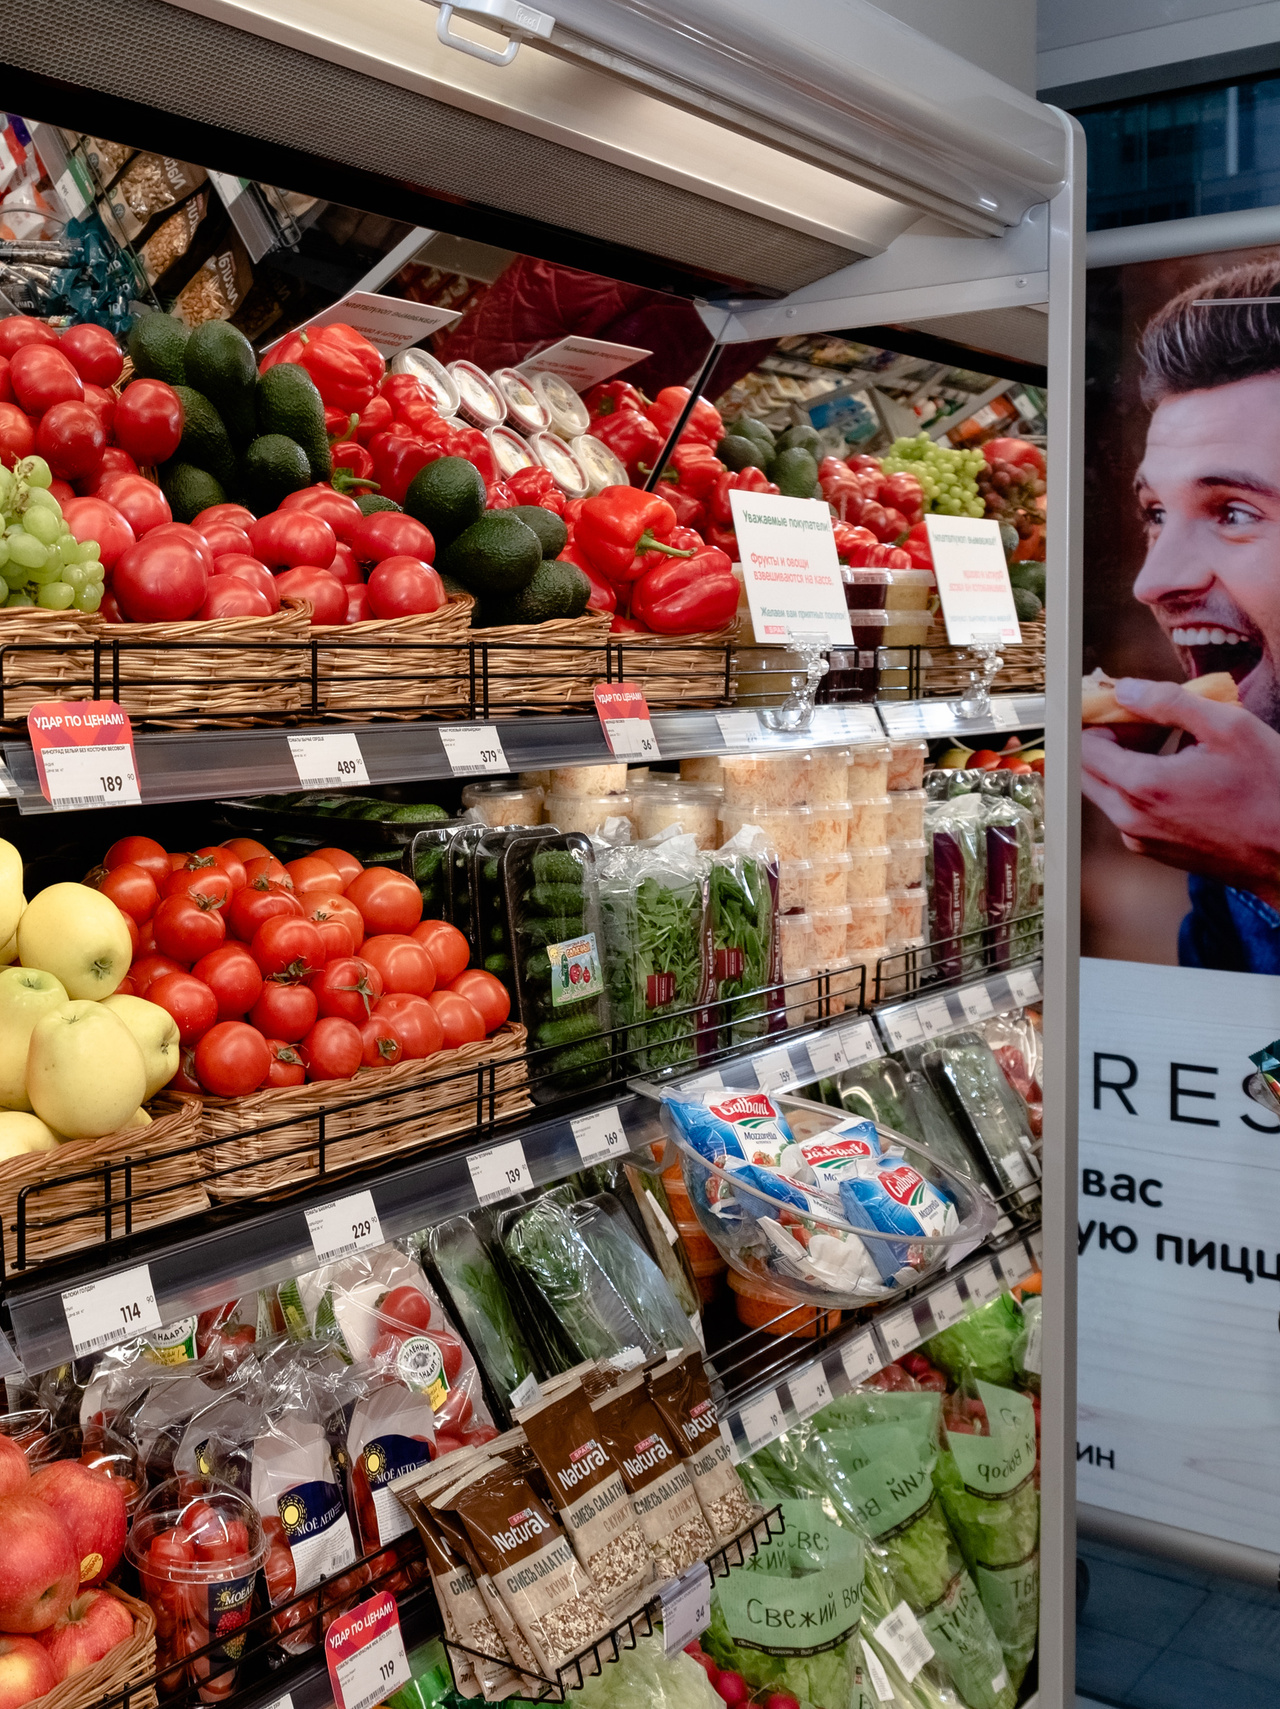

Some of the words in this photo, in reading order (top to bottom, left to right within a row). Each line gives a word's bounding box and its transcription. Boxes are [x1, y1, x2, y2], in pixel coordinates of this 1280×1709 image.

[742, 510, 788, 527] Уважаемые
[788, 517, 831, 532] покупатели!
[750, 552, 779, 569] Фрукты
[780, 557, 786, 566] и
[786, 558, 809, 570] овощи
[754, 570, 804, 583] взвешиваются
[805, 574, 813, 583] на
[814, 575, 834, 586] кассе.
[597, 694, 612, 704] УДАР
[613, 693, 622, 701] ПО
[34, 716, 62, 730] УДАР
[65, 715, 81, 727] ПО
[84, 713, 125, 728] ЦЕНАМ!
[642, 739, 652, 751] 36
[337, 760, 356, 774] 489
[480, 750, 497, 763] 379
[100, 776, 122, 792] 189
[705, 927, 714, 975] ТЕРРА
[865, 1040, 873, 1050] 49
[834, 1052, 842, 1063] 49
[780, 1070, 791, 1083] 159
[721, 1094, 770, 1117] Galbani
[605, 1131, 618, 1146] 169
[743, 1131, 778, 1141] Mozzarella
[505, 1168, 521, 1184] 139
[885, 1170, 920, 1199] Galbani
[1082, 1168, 1163, 1208] вас
[918, 1199, 941, 1221] Mozzarella
[352, 1220, 372, 1239] 229
[146, 1295, 155, 1304] 90
[120, 1302, 142, 1323] 114
[404, 1343, 431, 1361] ЗЕЛЁНЫЙ
[817, 1384, 826, 1397] 24
[682, 1406, 719, 1442] Natur
[771, 1414, 779, 1427] 19
[557, 1444, 610, 1490] Natural
[623, 1437, 673, 1479] Natural
[693, 1456, 718, 1478] СМЕСЬ
[377, 1468, 396, 1484] МОЁ
[396, 1462, 417, 1479] ЛЕТО
[633, 1490, 660, 1516] СМЕСЬ
[659, 1471, 691, 1499] САЛАТНА
[570, 1506, 596, 1529] СМЕСЬ
[593, 1480, 626, 1510] САЛАТН
[296, 1517, 320, 1536] МОЁ
[320, 1508, 336, 1529] ЛЕТО
[492, 1511, 550, 1553] Natural
[507, 1567, 537, 1594] СМЕСЬ
[533, 1545, 573, 1576] САЛАТНА
[449, 1573, 475, 1596] СМЕ
[696, 1605, 705, 1622] 34
[746, 1591, 838, 1629] Свежий
[329, 1628, 350, 1649] УДАР
[351, 1620, 363, 1636] ПО
[364, 1601, 394, 1629] ЦЕНАМ!
[380, 1660, 395, 1681] 119
